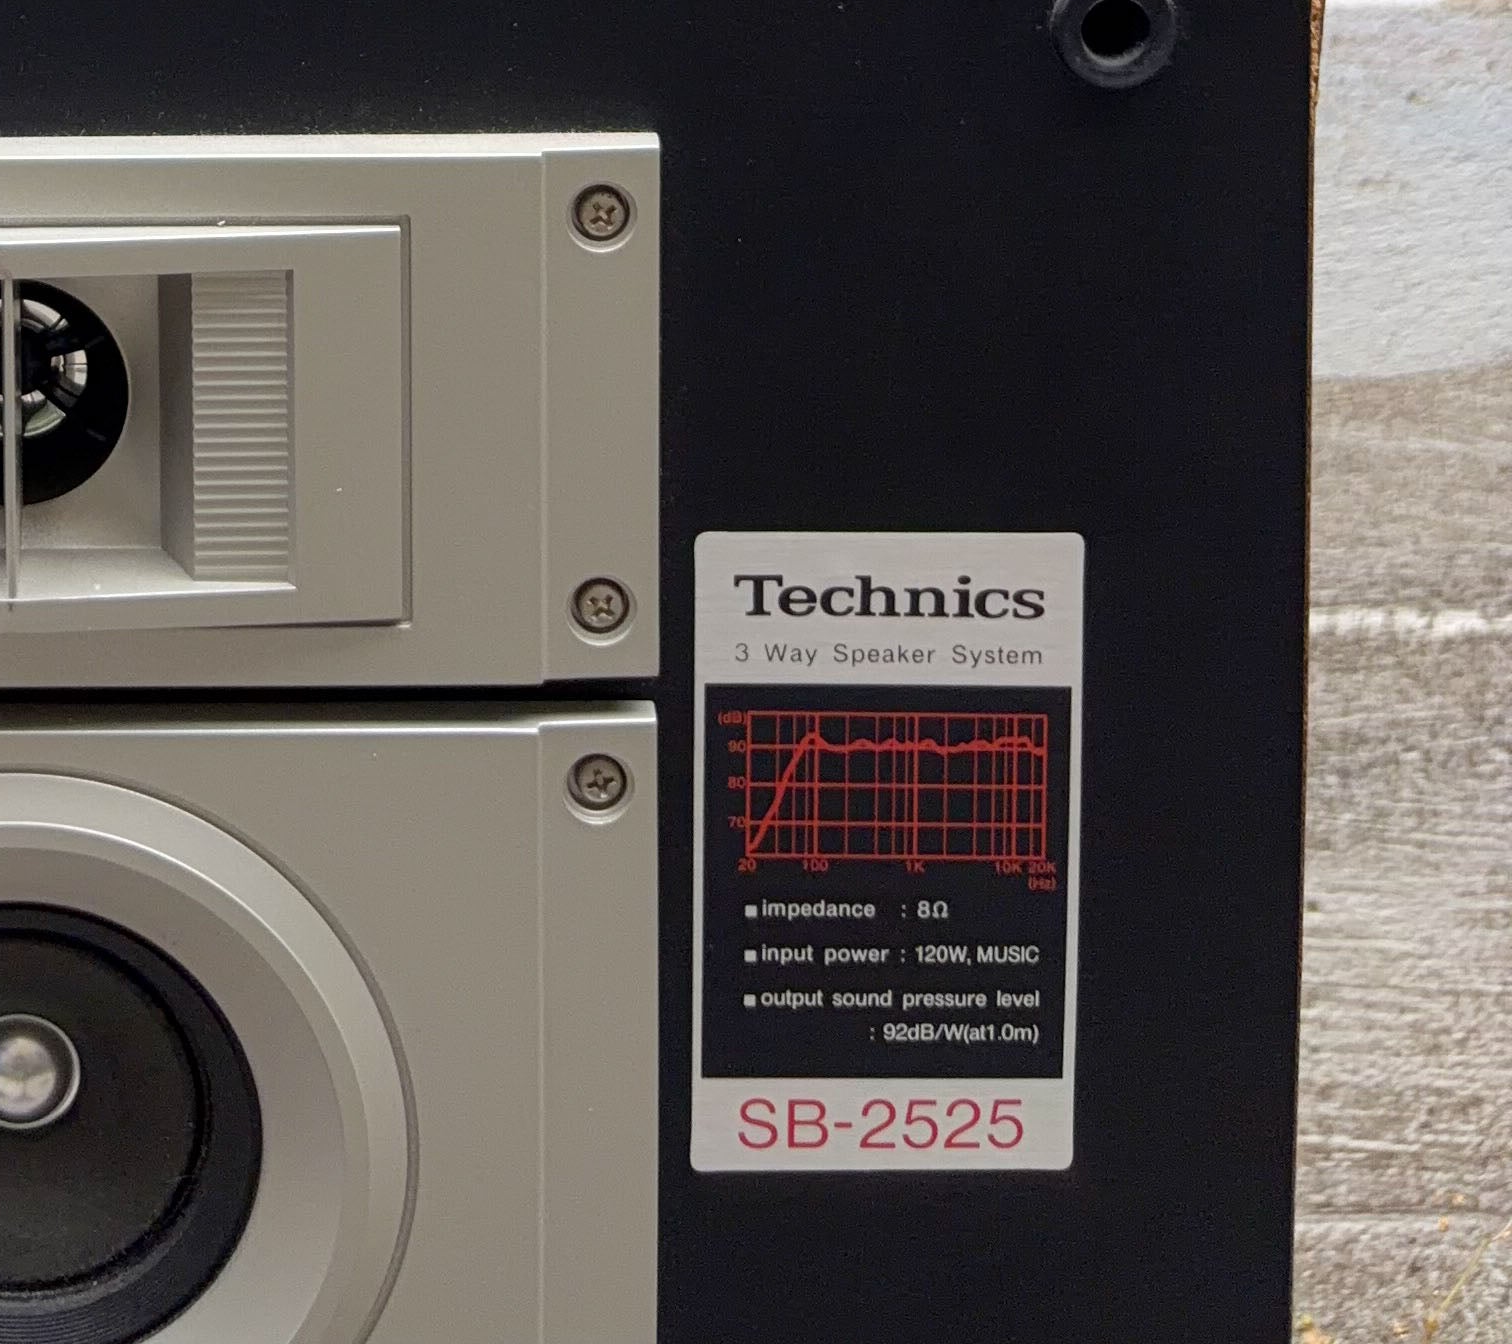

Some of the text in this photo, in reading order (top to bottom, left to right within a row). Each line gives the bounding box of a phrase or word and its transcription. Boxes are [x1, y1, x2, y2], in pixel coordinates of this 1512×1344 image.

[734, 574, 1045, 619] Technics
[735, 643, 1043, 668] 3 Way Speaker System
[728, 740, 746, 752] 90
[727, 776, 746, 788] 80
[728, 816, 746, 828] 70
[738, 859, 756, 872] 20
[803, 859, 828, 872] 100
[906, 861, 925, 873] 1K
[996, 861, 1023, 874] 10K
[761, 900, 876, 920] impedance
[917, 901, 948, 919] 8Ω
[761, 945, 813, 964] input
[824, 948, 889, 964] power
[915, 945, 972, 965] 120W,
[977, 946, 1040, 963] MUSIC
[761, 990, 1040, 1010] output sound pressure level
[737, 1098, 1025, 1149] SB-2525
